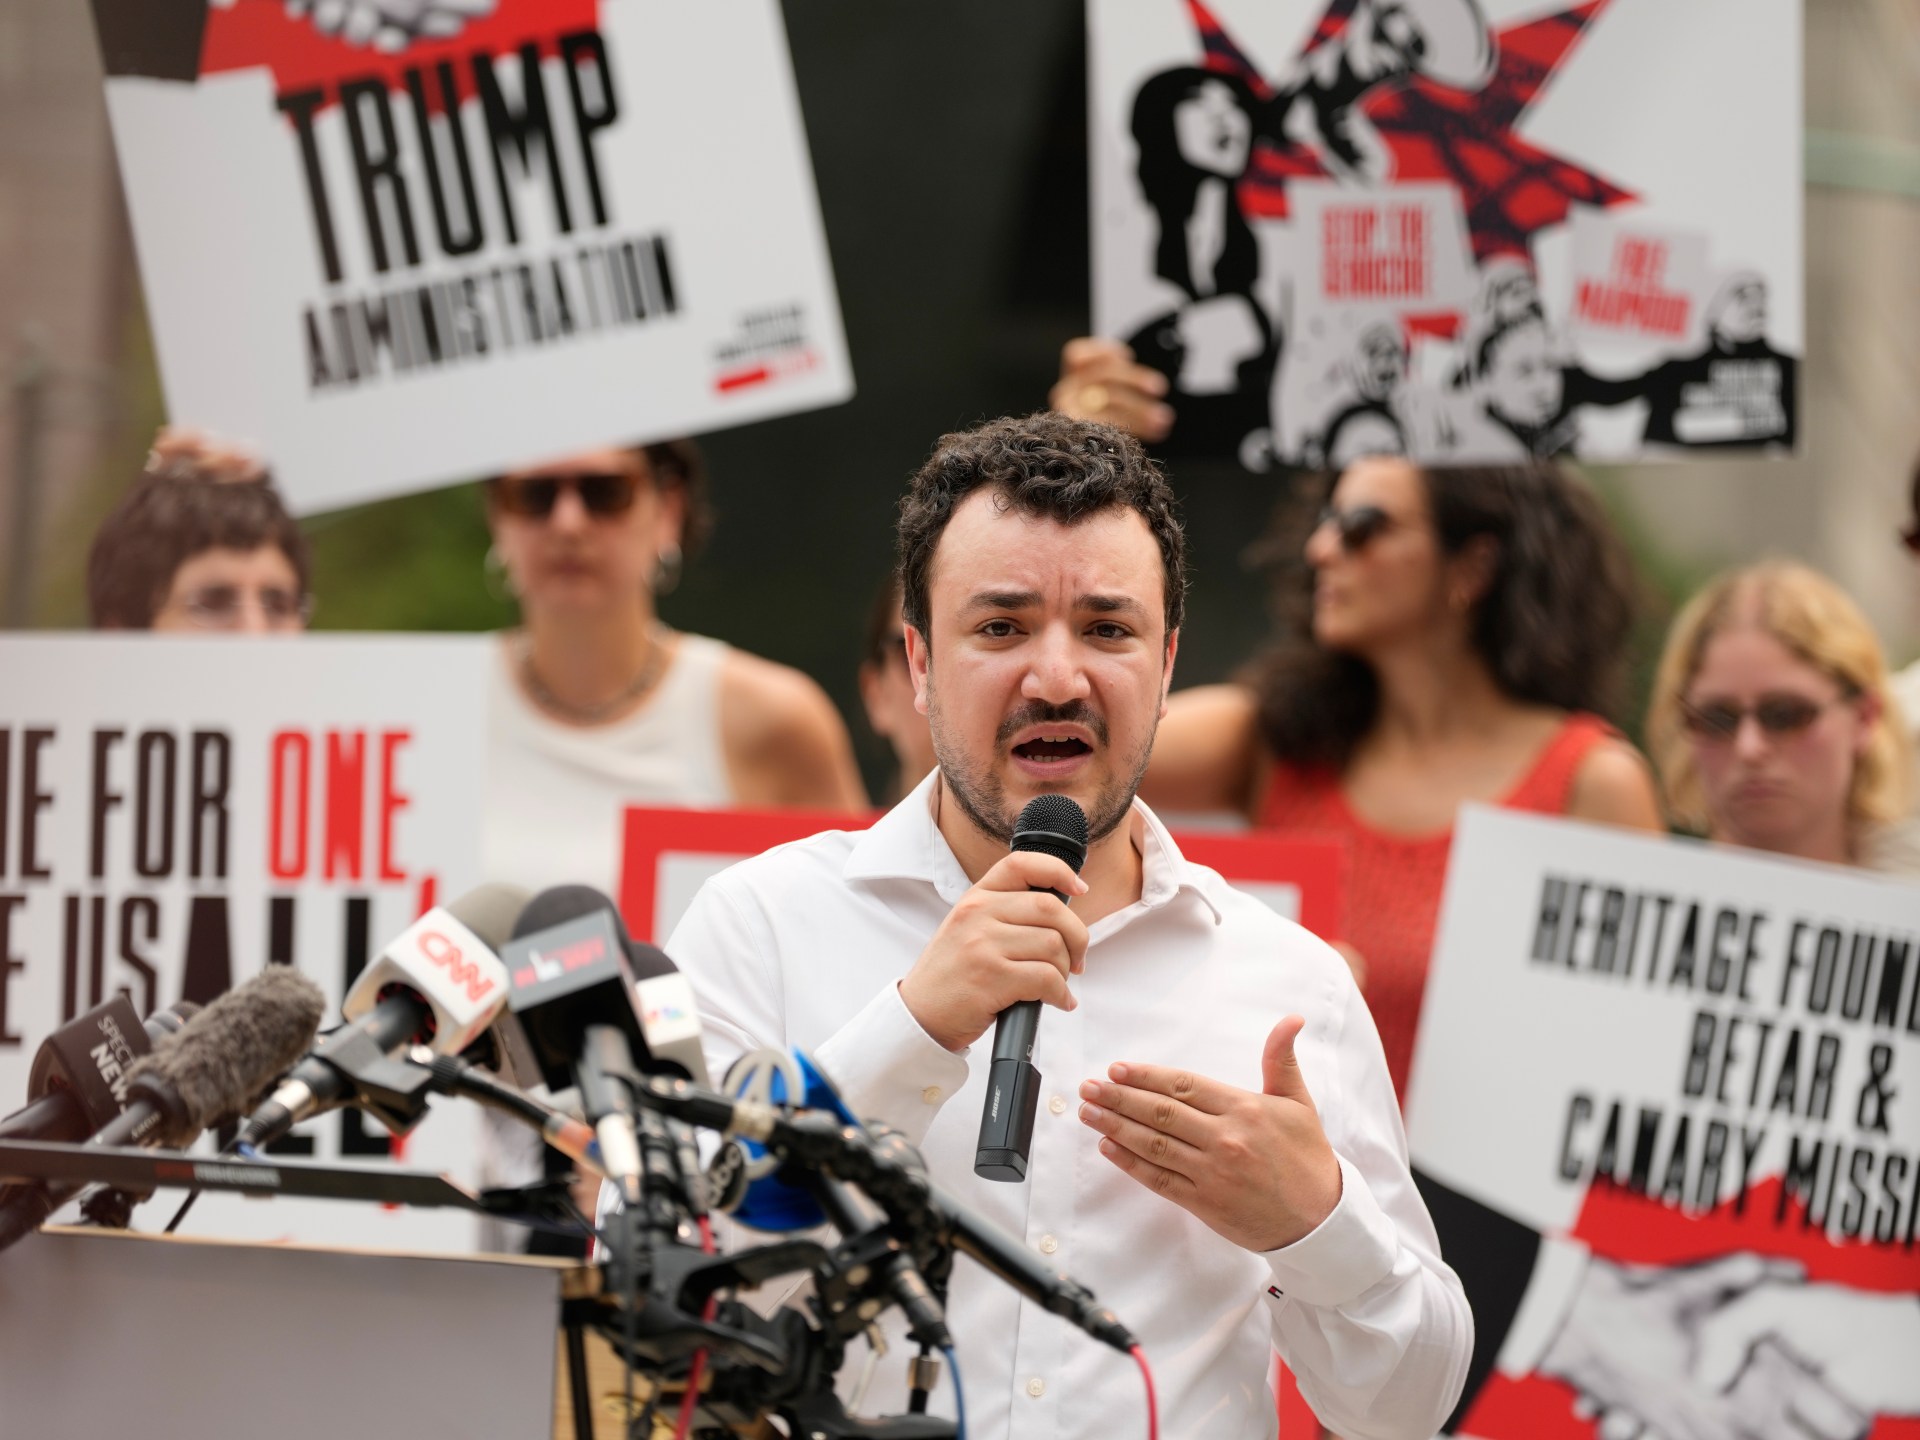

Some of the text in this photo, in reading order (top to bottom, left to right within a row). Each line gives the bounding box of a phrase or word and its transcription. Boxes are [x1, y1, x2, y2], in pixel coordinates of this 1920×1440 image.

[275, 28, 619, 284] TRUMP
[303, 232, 682, 390] ADMINISTRATION
[91, 728, 231, 881] FOR
[417, 930, 495, 1004] CNN
[1530, 872, 1768, 1000] HERITAGE
[990, 1084, 1002, 1123] BOSE
[1683, 1010, 1896, 1134] BETAR &
[1557, 1092, 1766, 1220] CANARY
